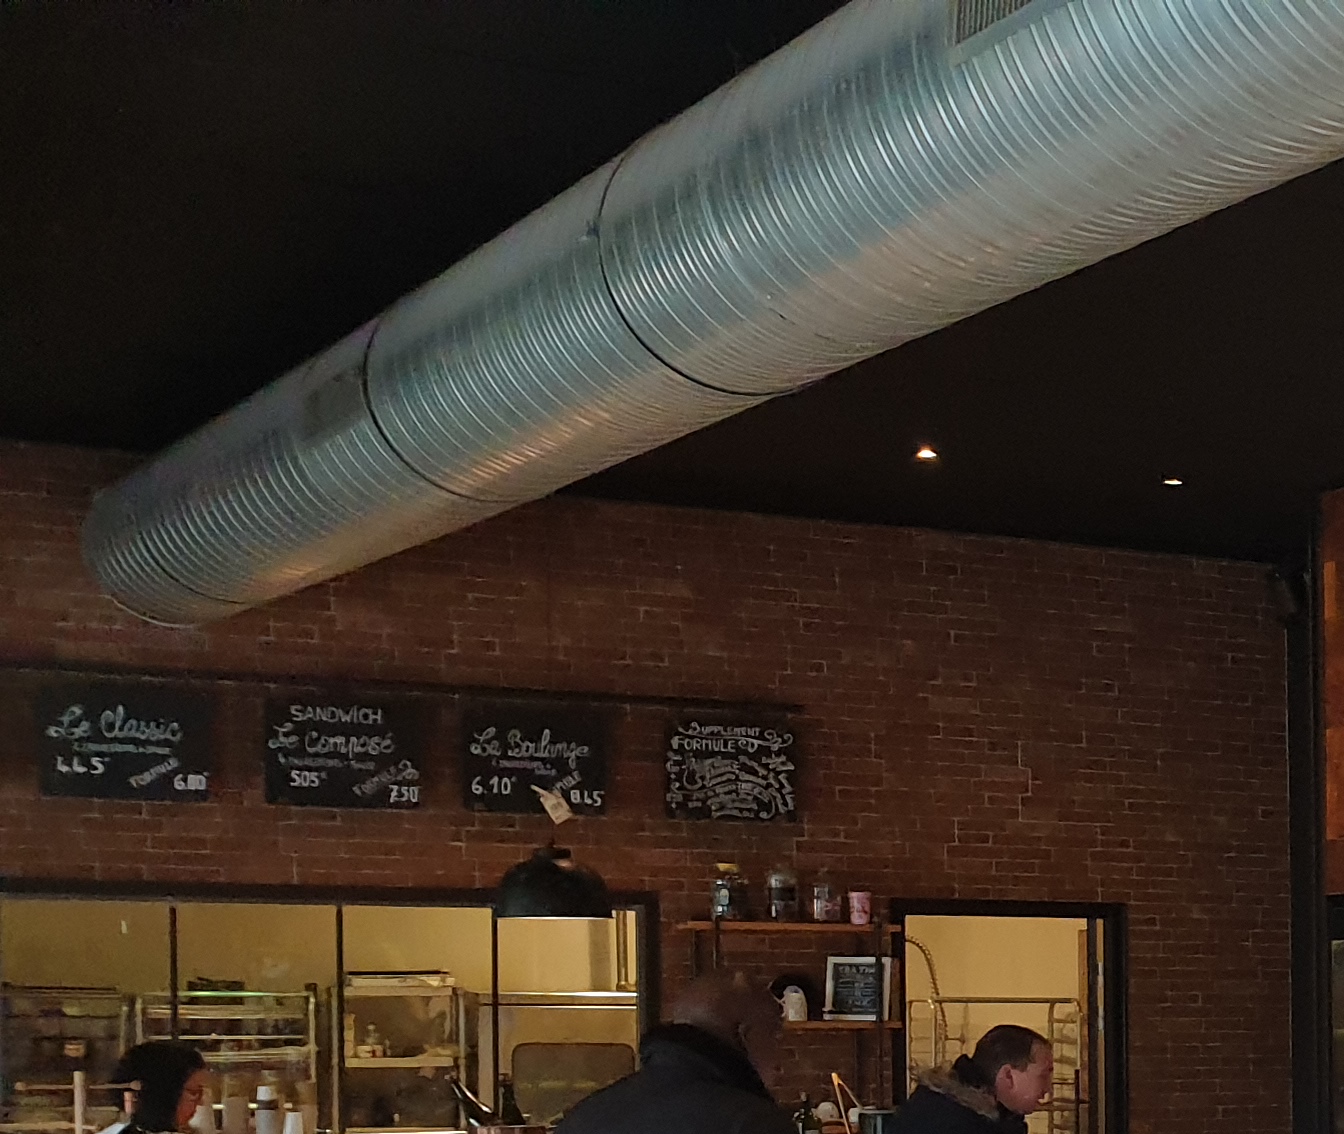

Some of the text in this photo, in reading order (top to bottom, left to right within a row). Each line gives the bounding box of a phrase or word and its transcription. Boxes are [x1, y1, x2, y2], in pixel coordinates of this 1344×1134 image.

[289, 705, 383, 724] SANDWICH
[507, 729, 590, 769] Boulange
[670, 735, 737, 753] FORMULE
